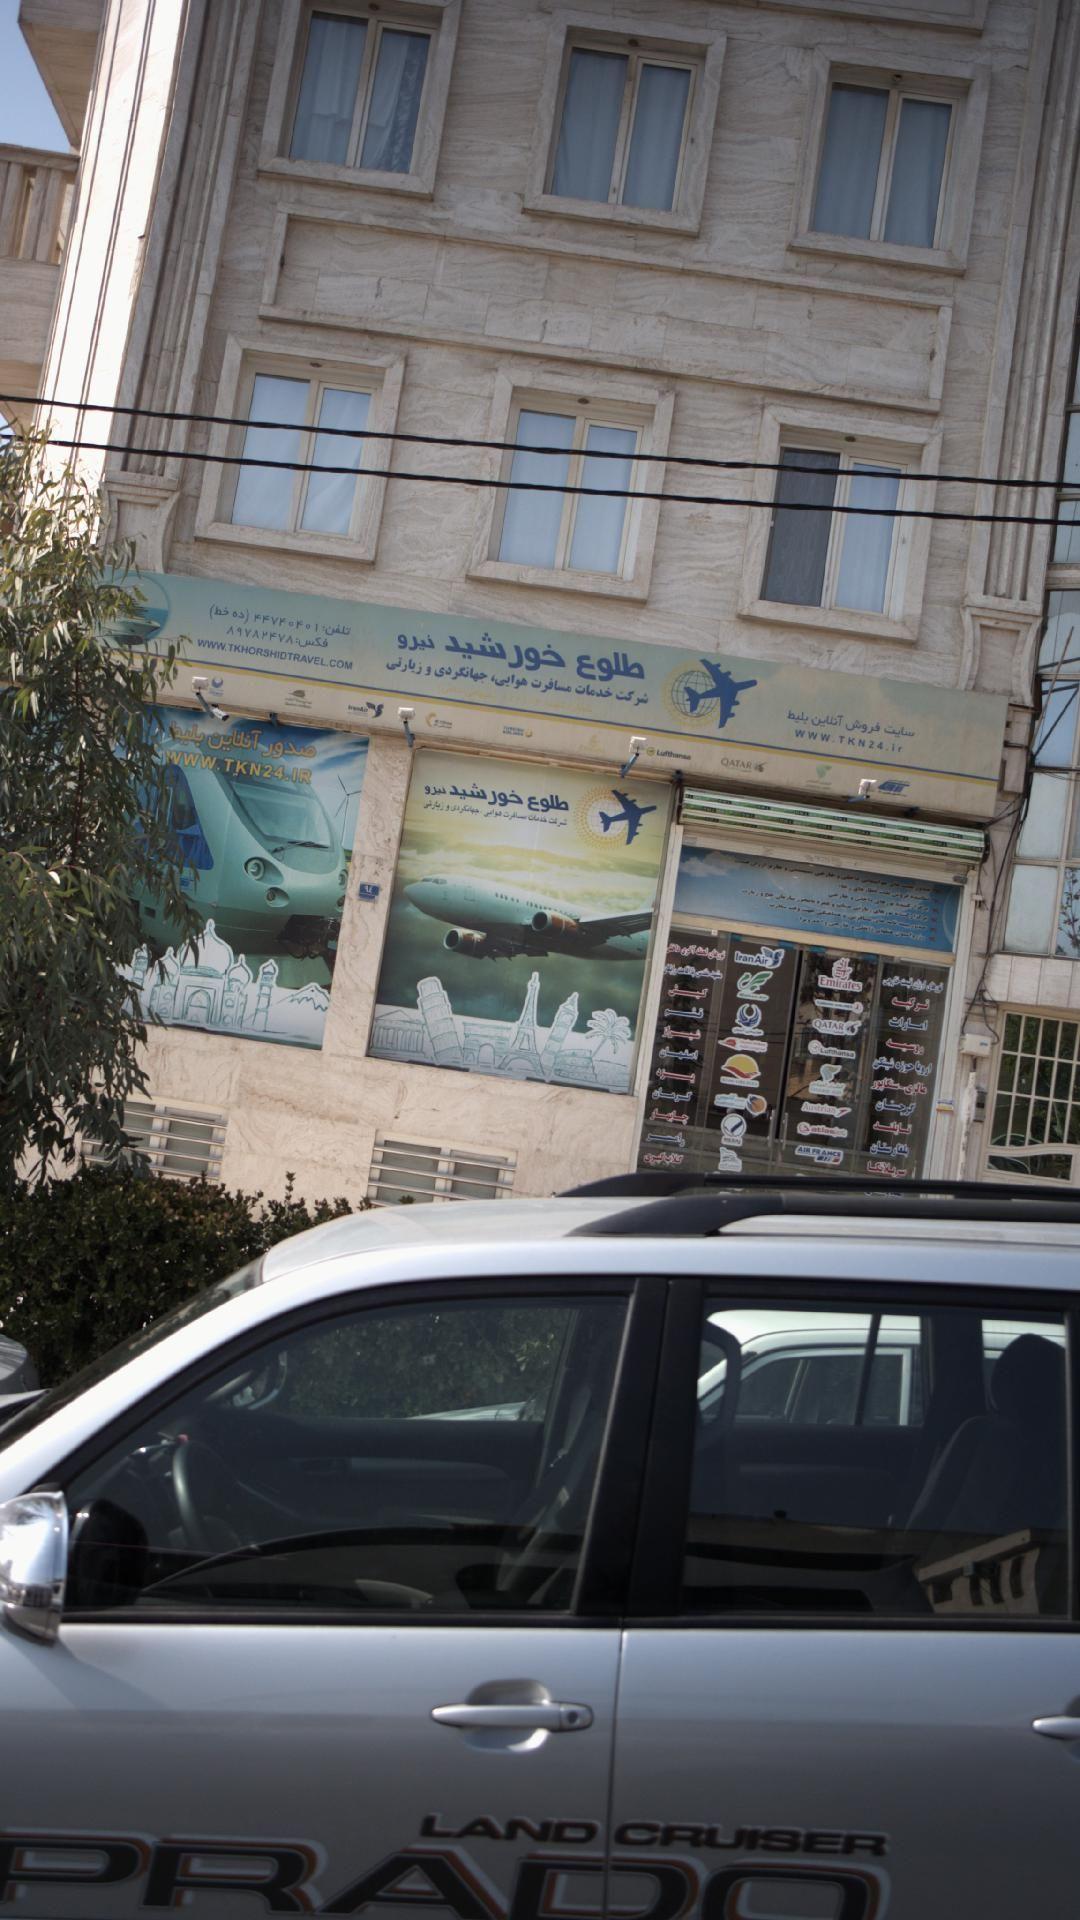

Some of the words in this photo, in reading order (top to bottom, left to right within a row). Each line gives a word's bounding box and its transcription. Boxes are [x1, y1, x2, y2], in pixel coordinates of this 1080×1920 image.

[209, 603, 230, 620] خط)
[397, 633, 435, 651] نیرو
[197, 639, 353, 670] WWW.TKHORSHIDTRAVEL.COM
[445, 632, 566, 671] خورشید
[386, 657, 422, 676] زیارتی
[424, 666, 432, 676] و
[434, 666, 488, 683] جهانگردی
[575, 651, 646, 682] طلوع
[531, 677, 572, 694] مسافرت
[575, 682, 613, 699] خدمات
[616, 689, 649, 706] شرکت
[787, 710, 808, 725] بلیط
[811, 714, 844, 728] آنلاین
[845, 719, 880, 734] فروش
[884, 724, 915, 737] سایت
[208, 729, 263, 751] آنلاین
[262, 738, 317, 759] صدور
[656, 749, 691, 760] Lufthansa
[166, 751, 312, 785] WWW.TKN24.IR
[720, 757, 752, 770] QATAR
[424, 784, 447, 796] نیرو
[450, 783, 523, 806] خورشید
[527, 794, 569, 812] طلوع
[735, 952, 769, 966] IranAir
[668, 983, 709, 999] کیش
[819, 976, 861, 991] Emirates
[892, 996, 930, 1012] ترکیه
[664, 1006, 704, 1019] قشم
[813, 1019, 844, 1031] QATAR
[888, 1017, 928, 1031] امارات
[820, 1046, 855, 1058] Lufthansa
[886, 1038, 924, 1055] روسیه
[652, 1087, 693, 1102] کرمان
[802, 1102, 836, 1114] Austrian
[872, 1121, 912, 1135] تایلند
[798, 1146, 812, 1155] AIR
[420, 1814, 598, 1844] LAND
[613, 1821, 889, 1856] CRUISER
[0, 1828, 890, 1920] PRADO
